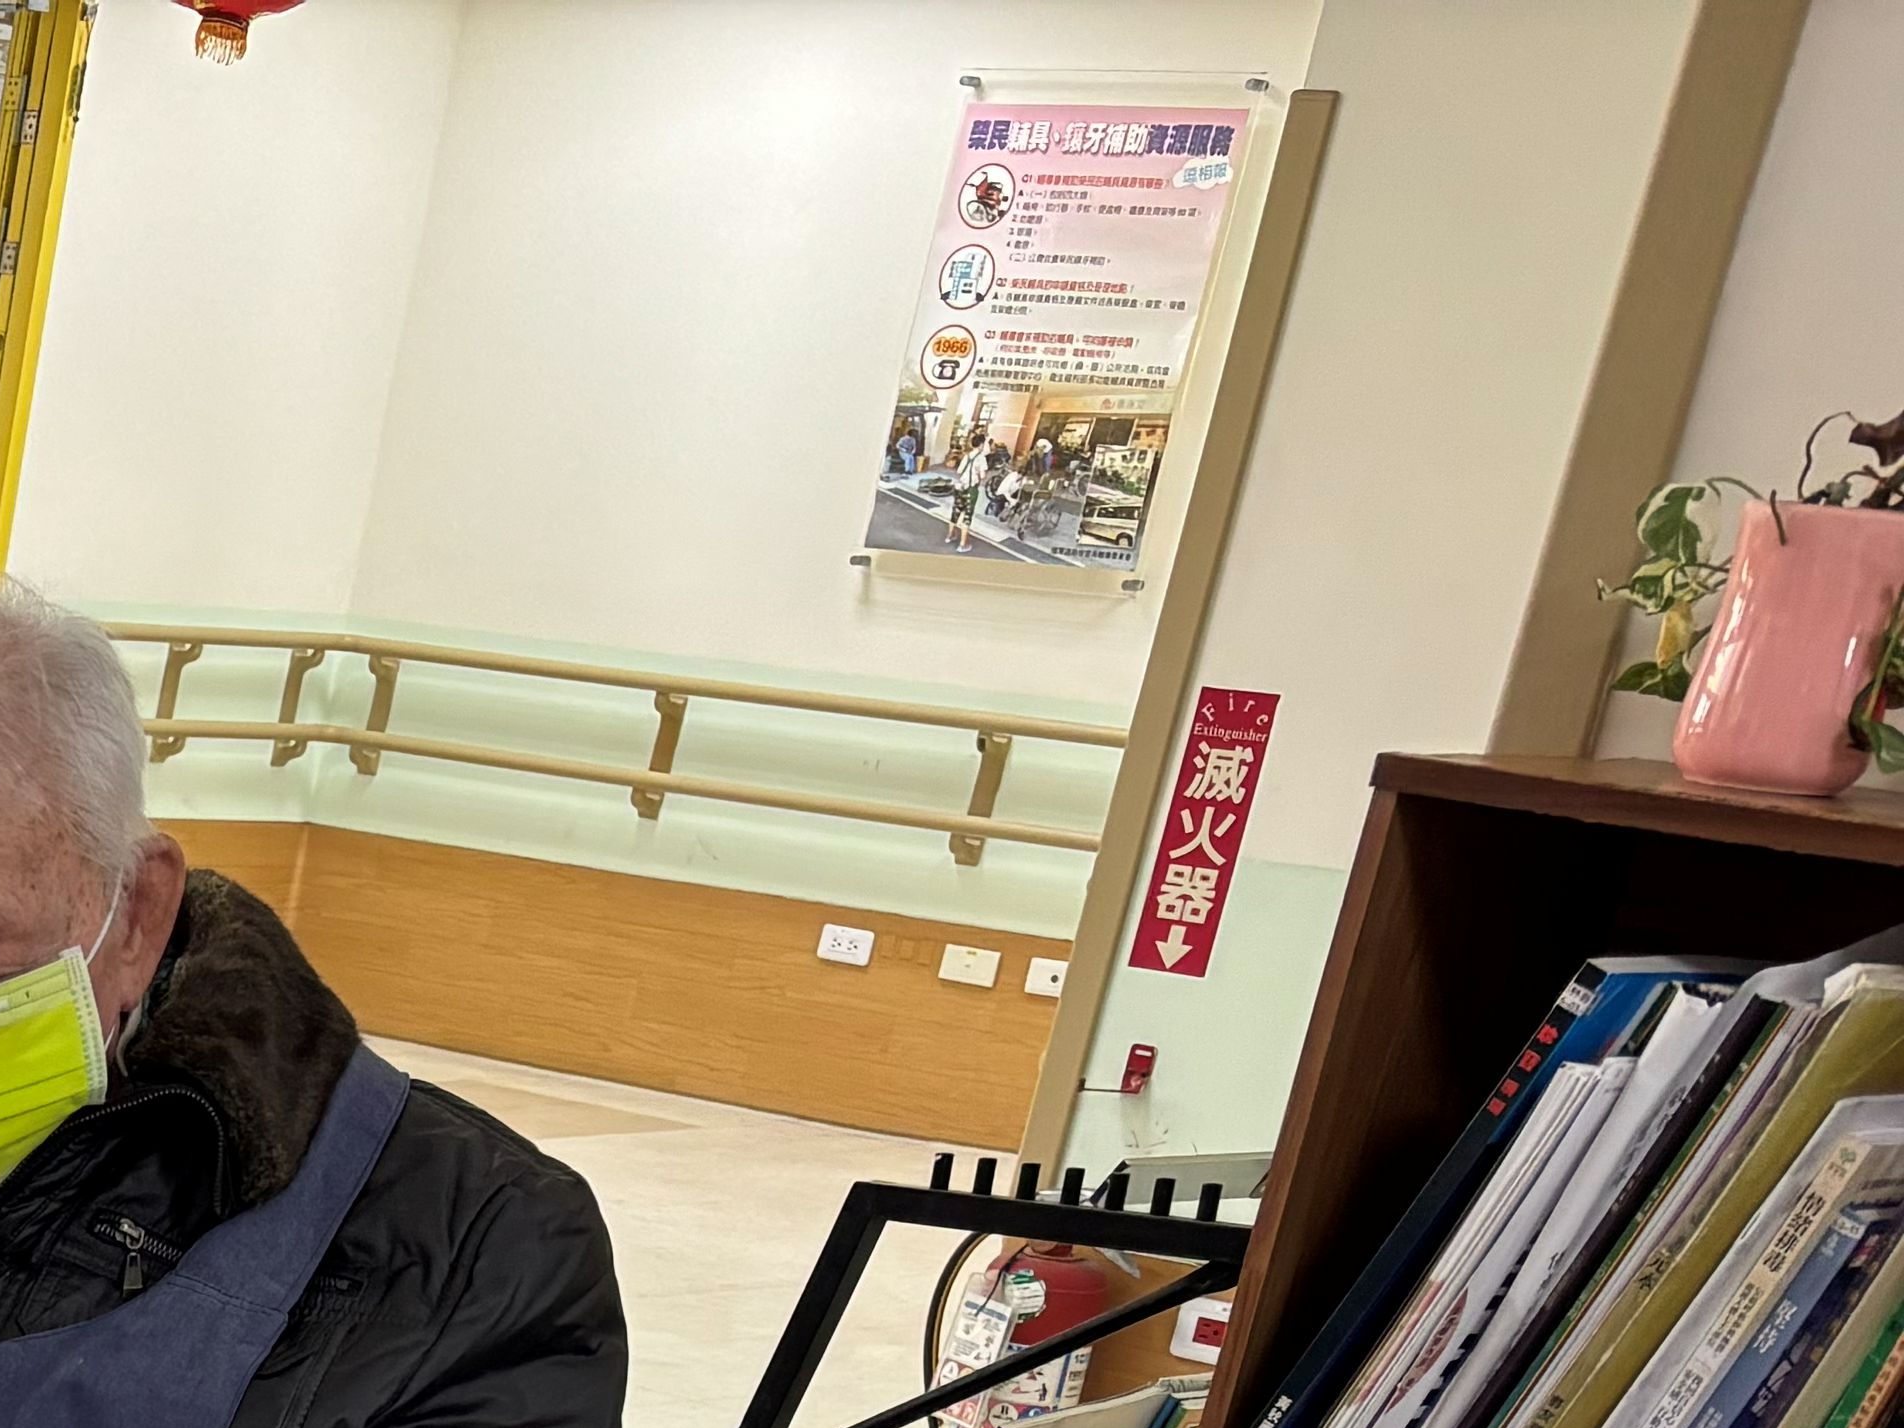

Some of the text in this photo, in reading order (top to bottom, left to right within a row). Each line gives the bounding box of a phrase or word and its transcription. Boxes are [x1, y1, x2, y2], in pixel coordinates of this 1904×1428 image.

[933, 339, 970, 355] 1966
[1201, 692, 1269, 726] Fire
[1192, 721, 1268, 744] Extinguisher
[1156, 741, 1255, 924] 滅火器
[1763, 1191, 1826, 1273] 情緒排毒
